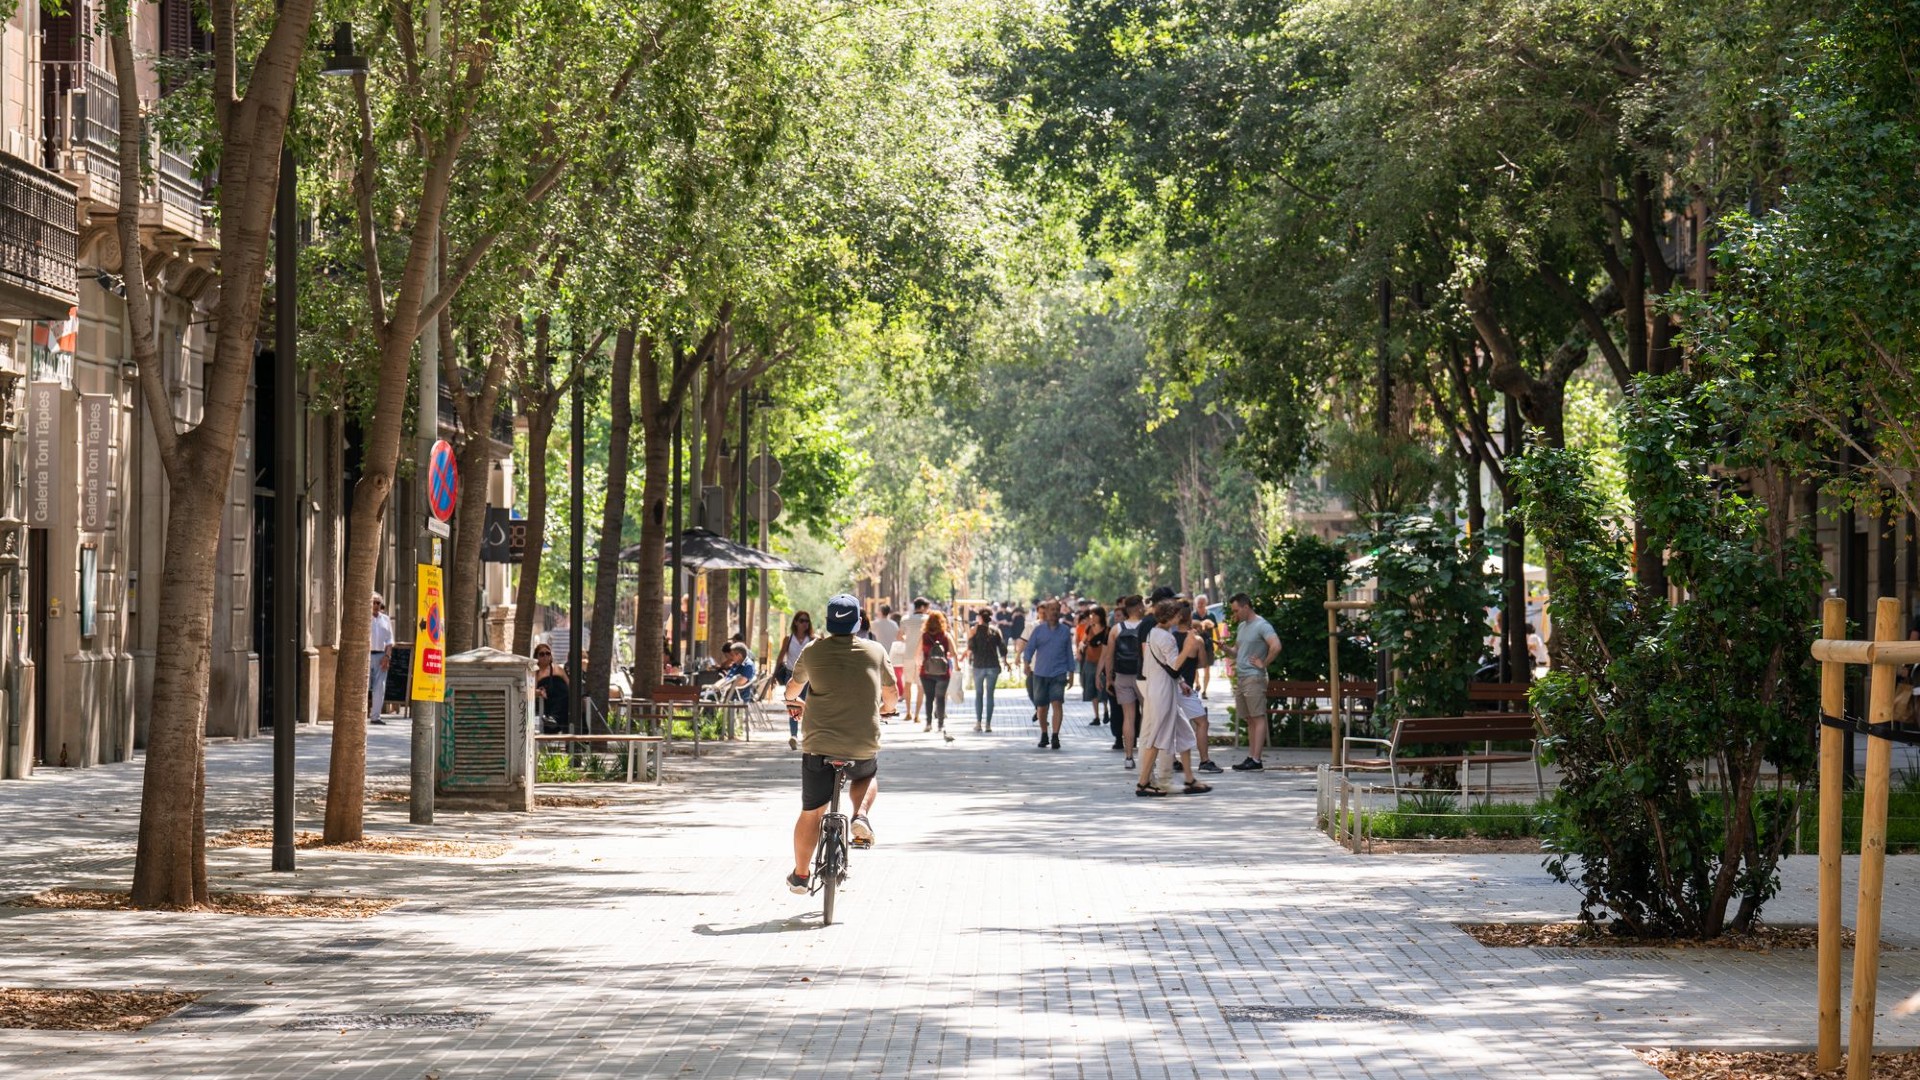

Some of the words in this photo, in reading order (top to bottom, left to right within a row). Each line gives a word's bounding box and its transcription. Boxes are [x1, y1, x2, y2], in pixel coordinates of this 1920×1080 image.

[35, 390, 52, 438] Tàpies
[86, 403, 102, 447] Tàpies
[35, 440, 49, 469] Toni
[86, 449, 99, 477] Toni
[34, 471, 49, 522] Galeria
[85, 478, 98, 527] Galeria
